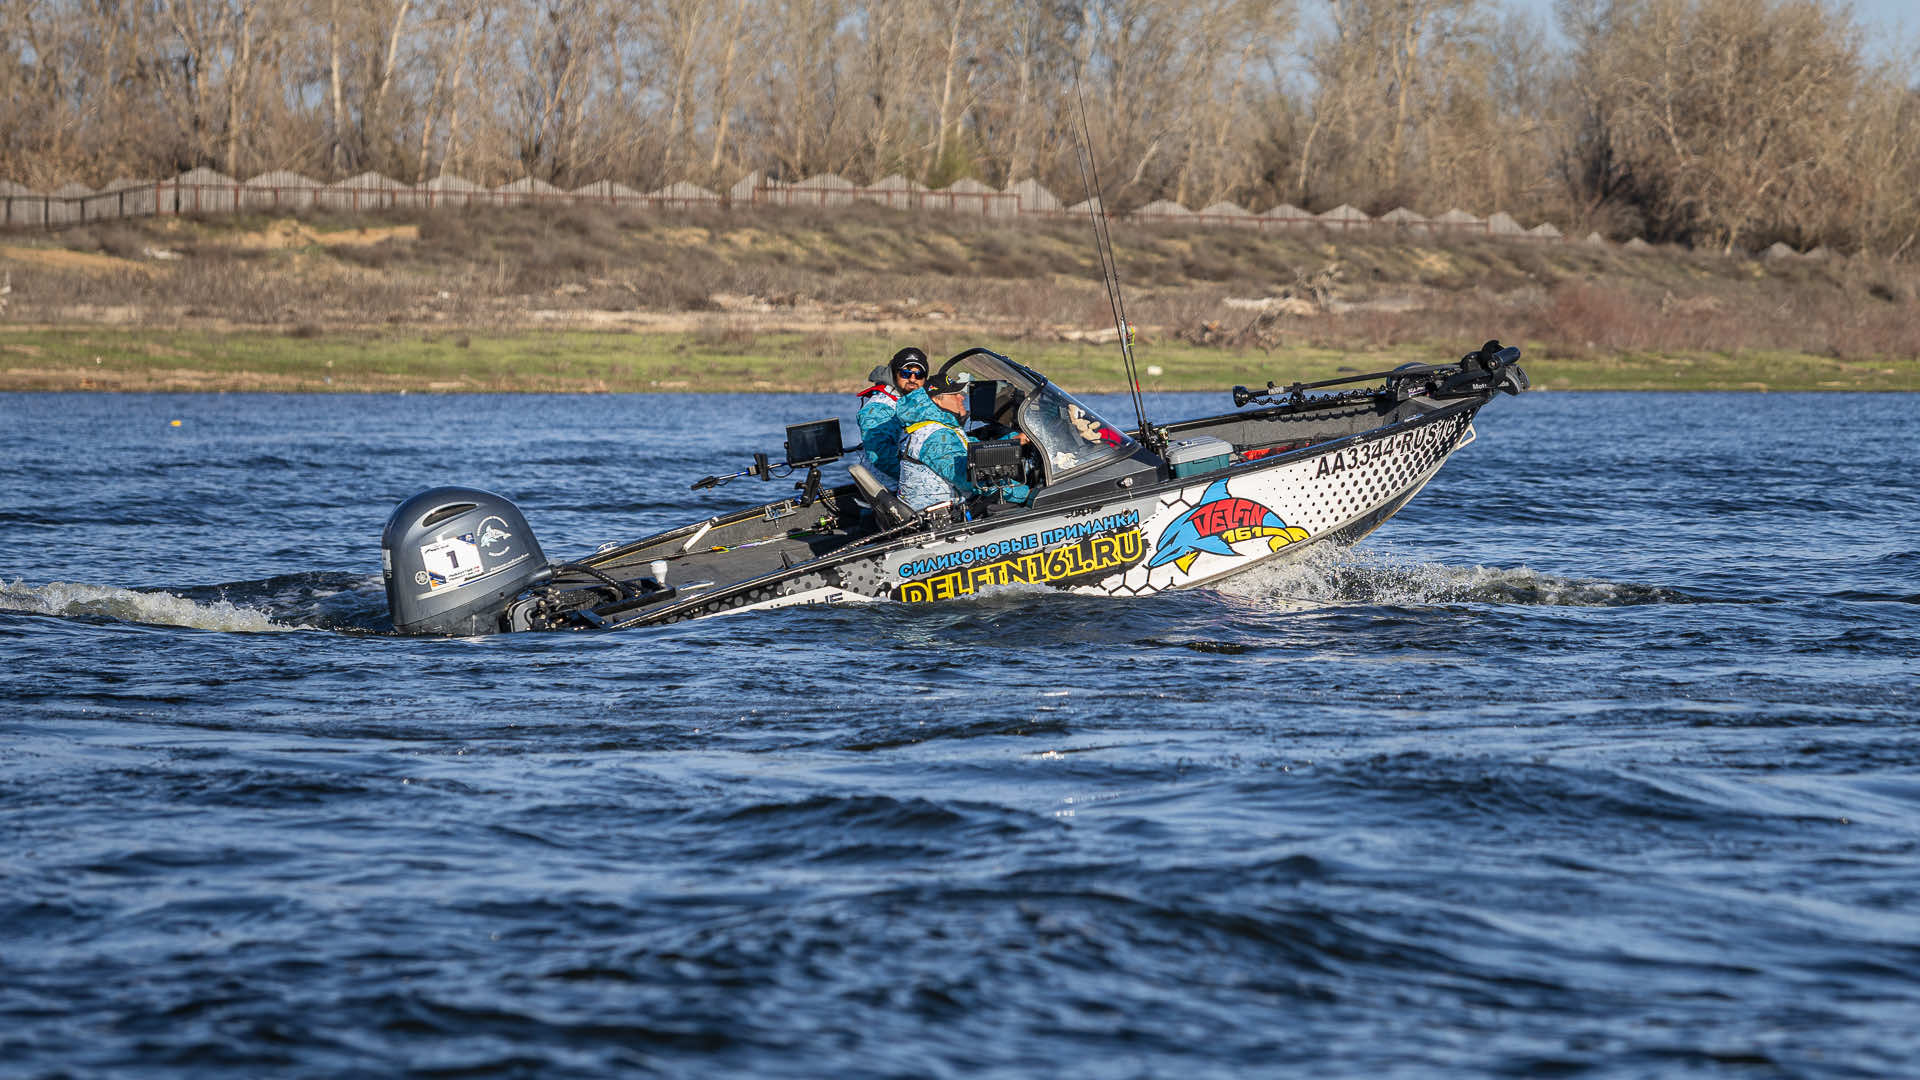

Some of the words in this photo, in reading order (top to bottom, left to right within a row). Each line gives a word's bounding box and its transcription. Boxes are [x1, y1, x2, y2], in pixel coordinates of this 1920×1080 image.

[899, 533, 1039, 578] СИЛИКОНОВЫЕ
[1041, 509, 1140, 546] ПРИМАНКИ
[1222, 526, 1262, 544] 161
[446, 550, 459, 569] 1
[900, 529, 1142, 603] DELFIN161.RU
